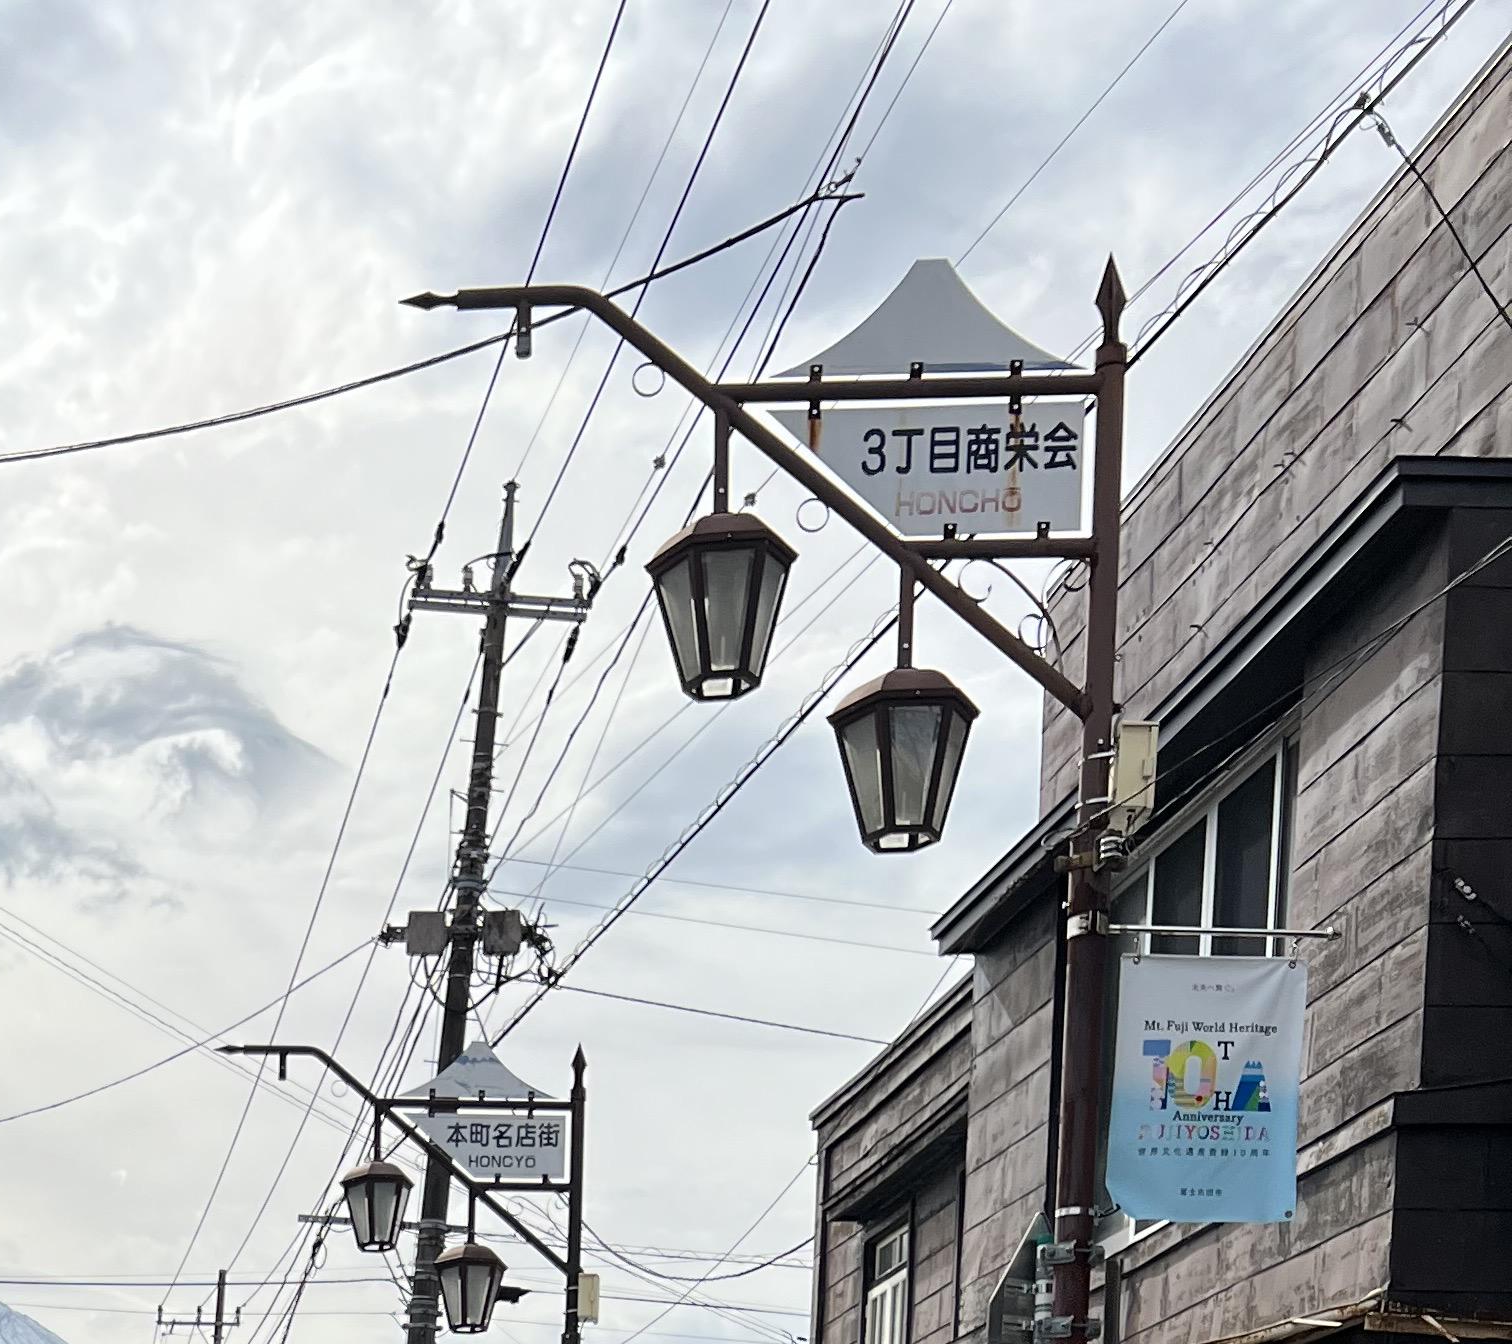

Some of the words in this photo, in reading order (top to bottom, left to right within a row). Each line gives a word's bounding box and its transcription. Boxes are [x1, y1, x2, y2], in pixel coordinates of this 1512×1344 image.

[861, 422, 1078, 476] 3丁目商栄会
[1167, 1020, 1189, 1034] Fuji
[1192, 1021, 1225, 1033] World
[1229, 1022, 1278, 1036] Heritage
[1172, 1110, 1245, 1126] Anniversary
[446, 1122, 560, 1148] 本町名店街
